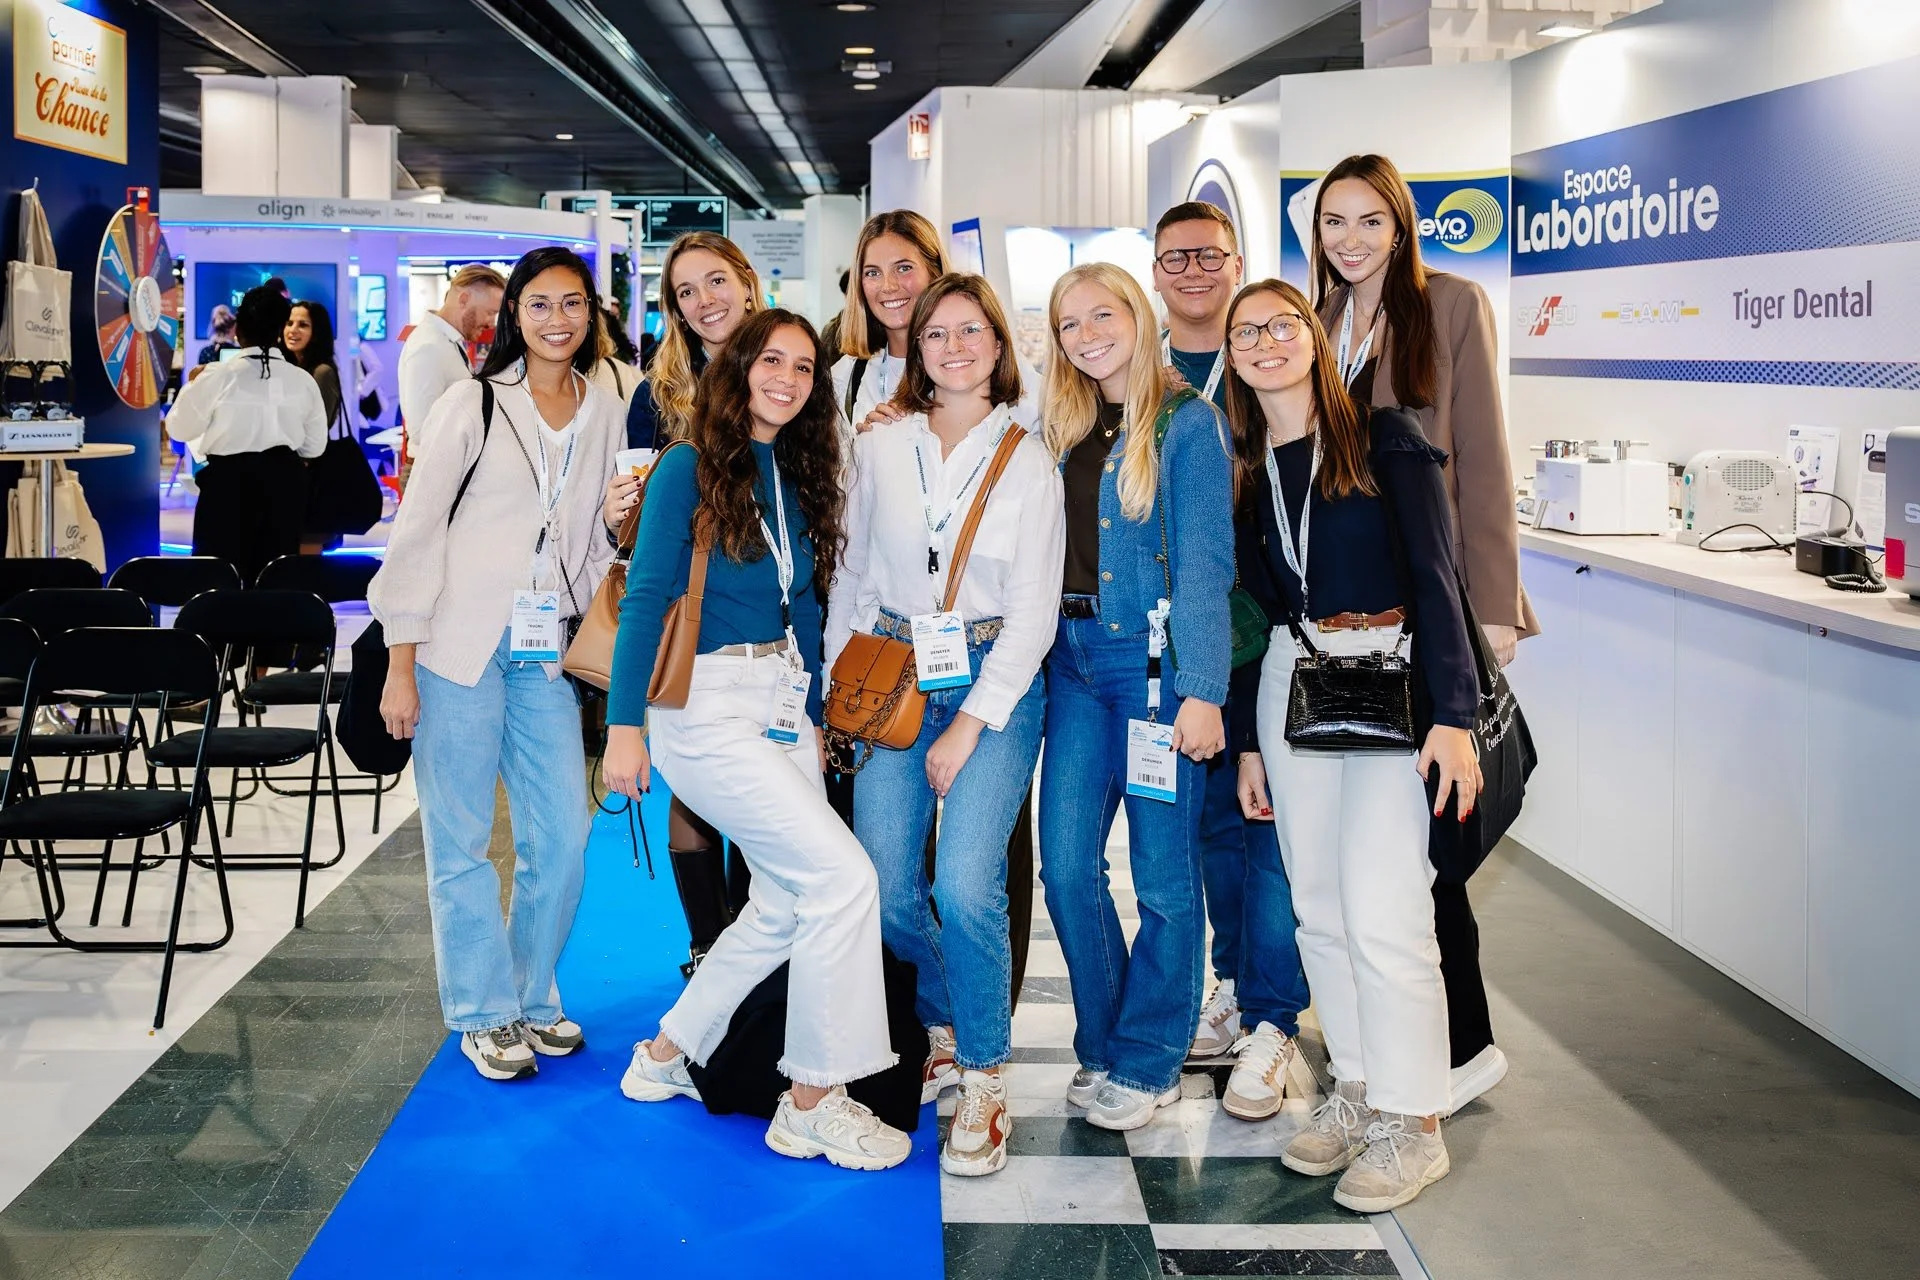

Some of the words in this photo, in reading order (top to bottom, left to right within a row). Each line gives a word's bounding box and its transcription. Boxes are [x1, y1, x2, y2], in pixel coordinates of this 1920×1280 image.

[35, 71, 110, 137] Chance
[1564, 164, 1632, 203] Espace
[257, 200, 306, 220] align
[1418, 217, 1467, 237] evo
[1517, 177, 1720, 254] Laboratoire
[1517, 305, 1577, 327] SCHEU
[1732, 287, 1786, 329] Tiger
[1793, 279, 1873, 319] Dental
